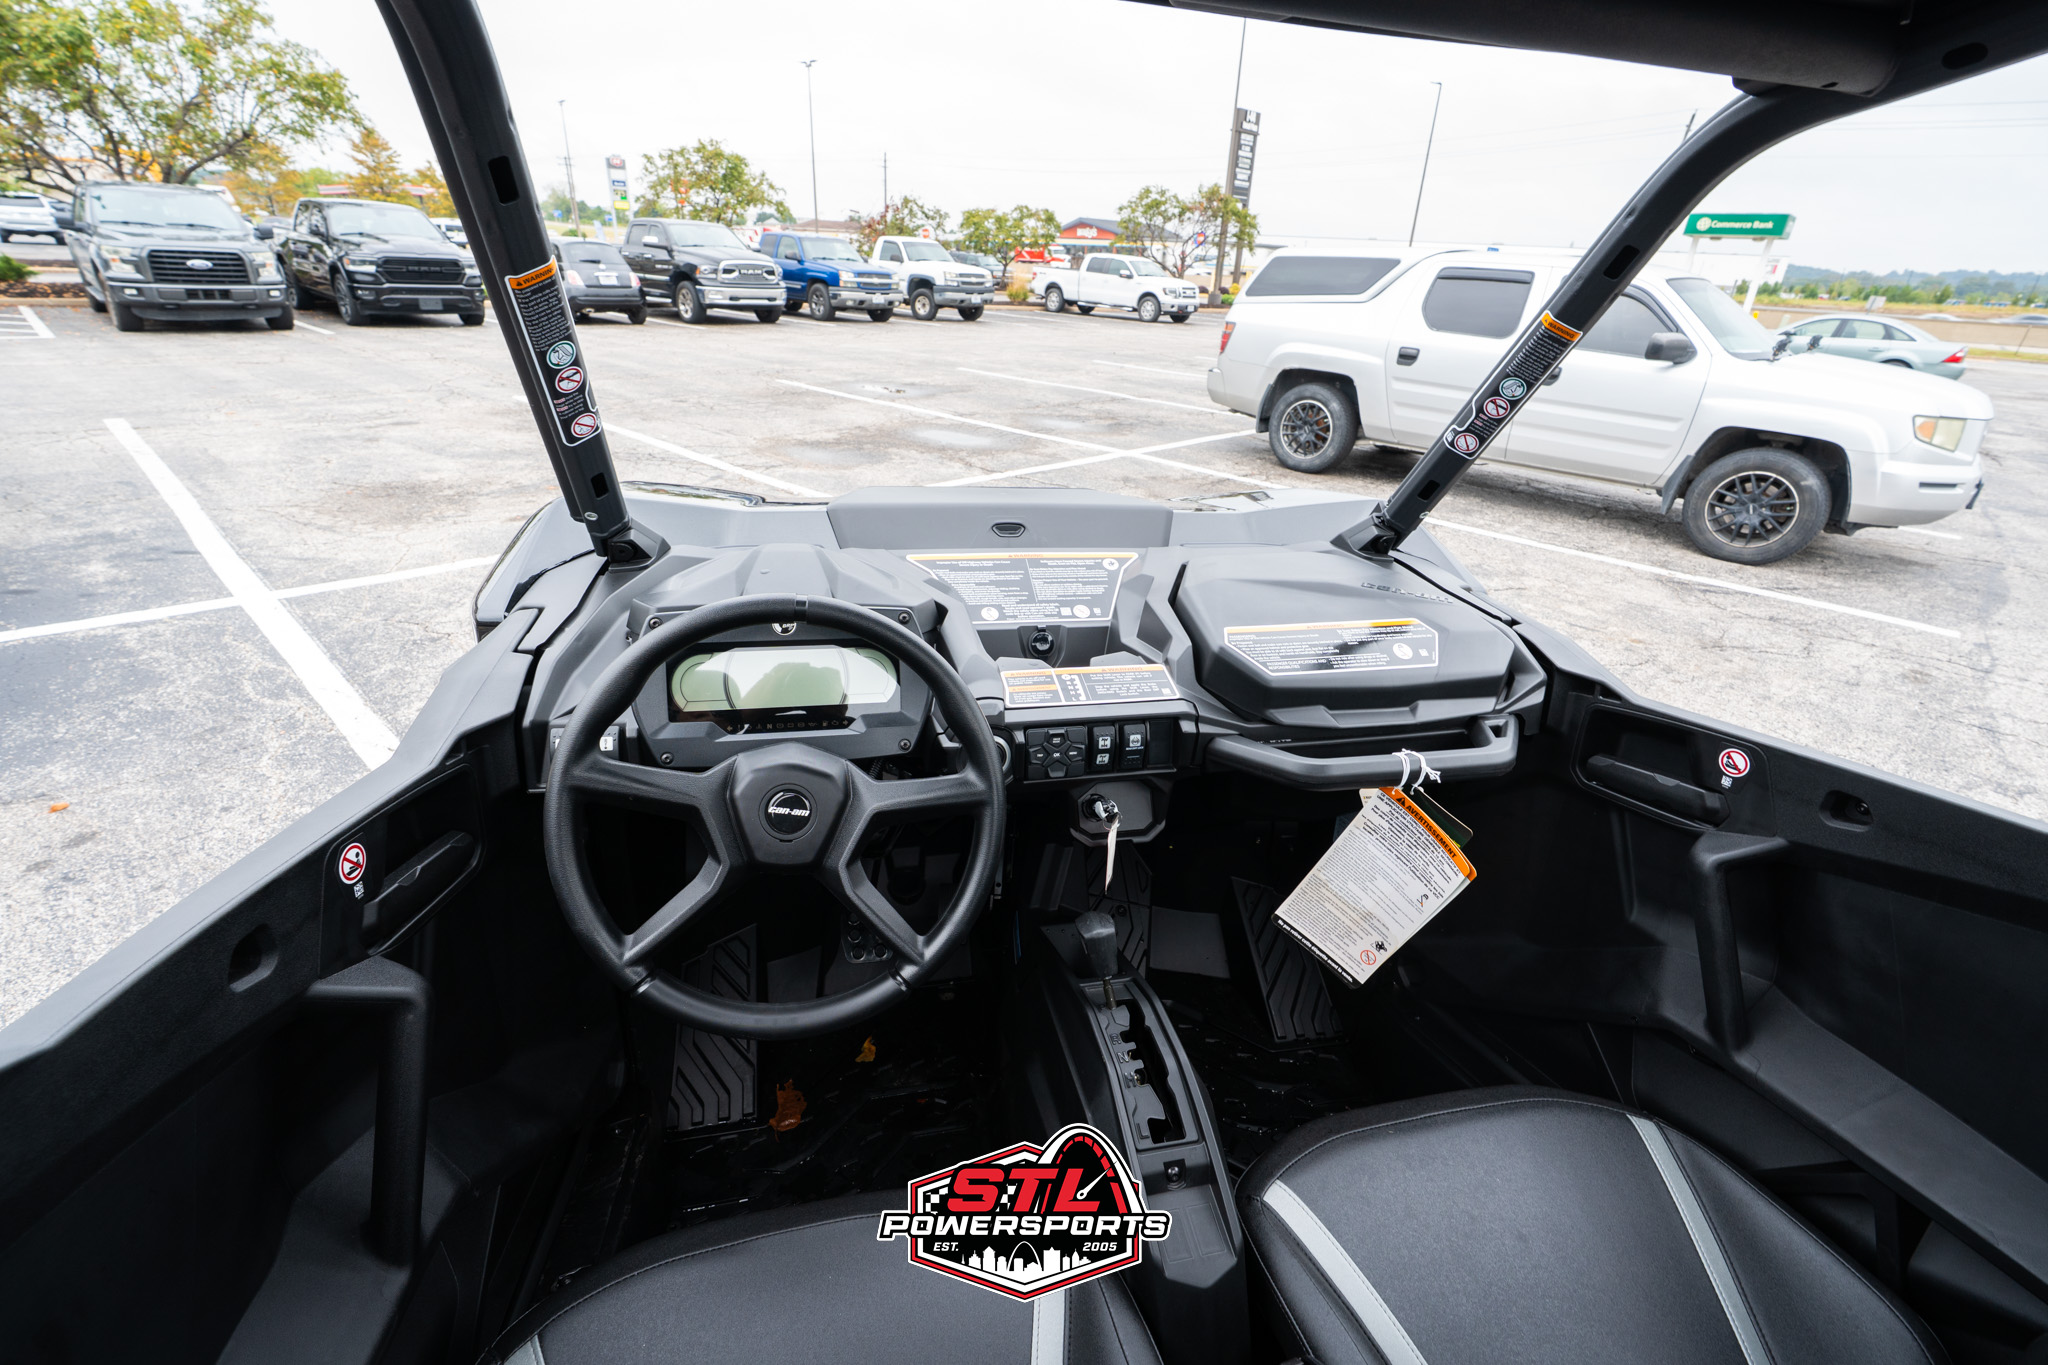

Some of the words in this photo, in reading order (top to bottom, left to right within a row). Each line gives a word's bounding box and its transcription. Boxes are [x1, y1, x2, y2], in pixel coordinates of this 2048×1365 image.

[1711, 220, 1752, 229] Commerce
[1753, 220, 1774, 229] Bank
[1547, 321, 1574, 338] WARNING
[768, 806, 810, 816] can-am
[1406, 806, 1457, 858] AVERTISSEMENT
[1110, 1033, 1122, 1046] R
[1117, 1052, 1128, 1063] N
[1124, 1072, 1137, 1088] H
[1136, 1122, 1150, 1140] L
